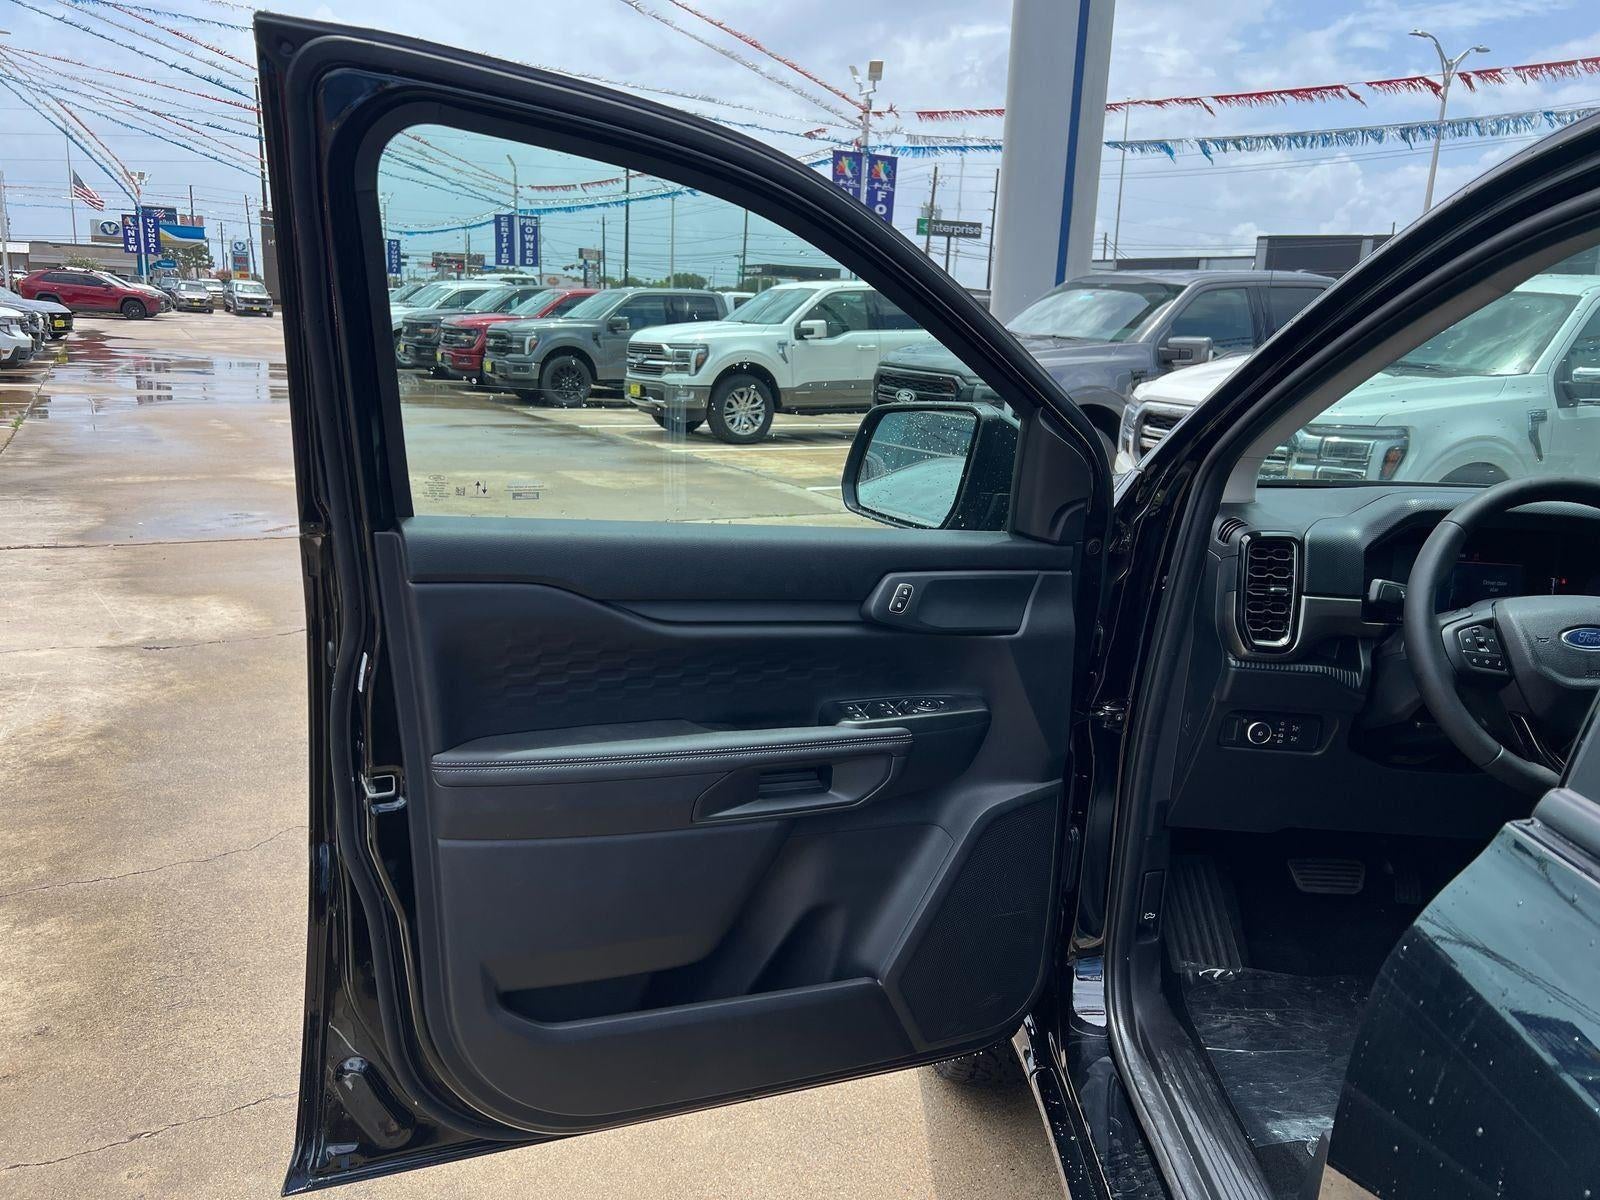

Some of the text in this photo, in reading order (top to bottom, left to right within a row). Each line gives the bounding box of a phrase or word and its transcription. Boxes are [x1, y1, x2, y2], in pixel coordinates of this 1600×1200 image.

[520, 218, 537, 227] PRE
[874, 191, 887, 221] FO
[127, 230, 138, 252] NEW
[146, 218, 157, 253] HYUNDAI
[500, 216, 510, 264] CERTIFIED
[524, 226, 535, 265] OWNED
[390, 240, 398, 273] HYUNDAI
